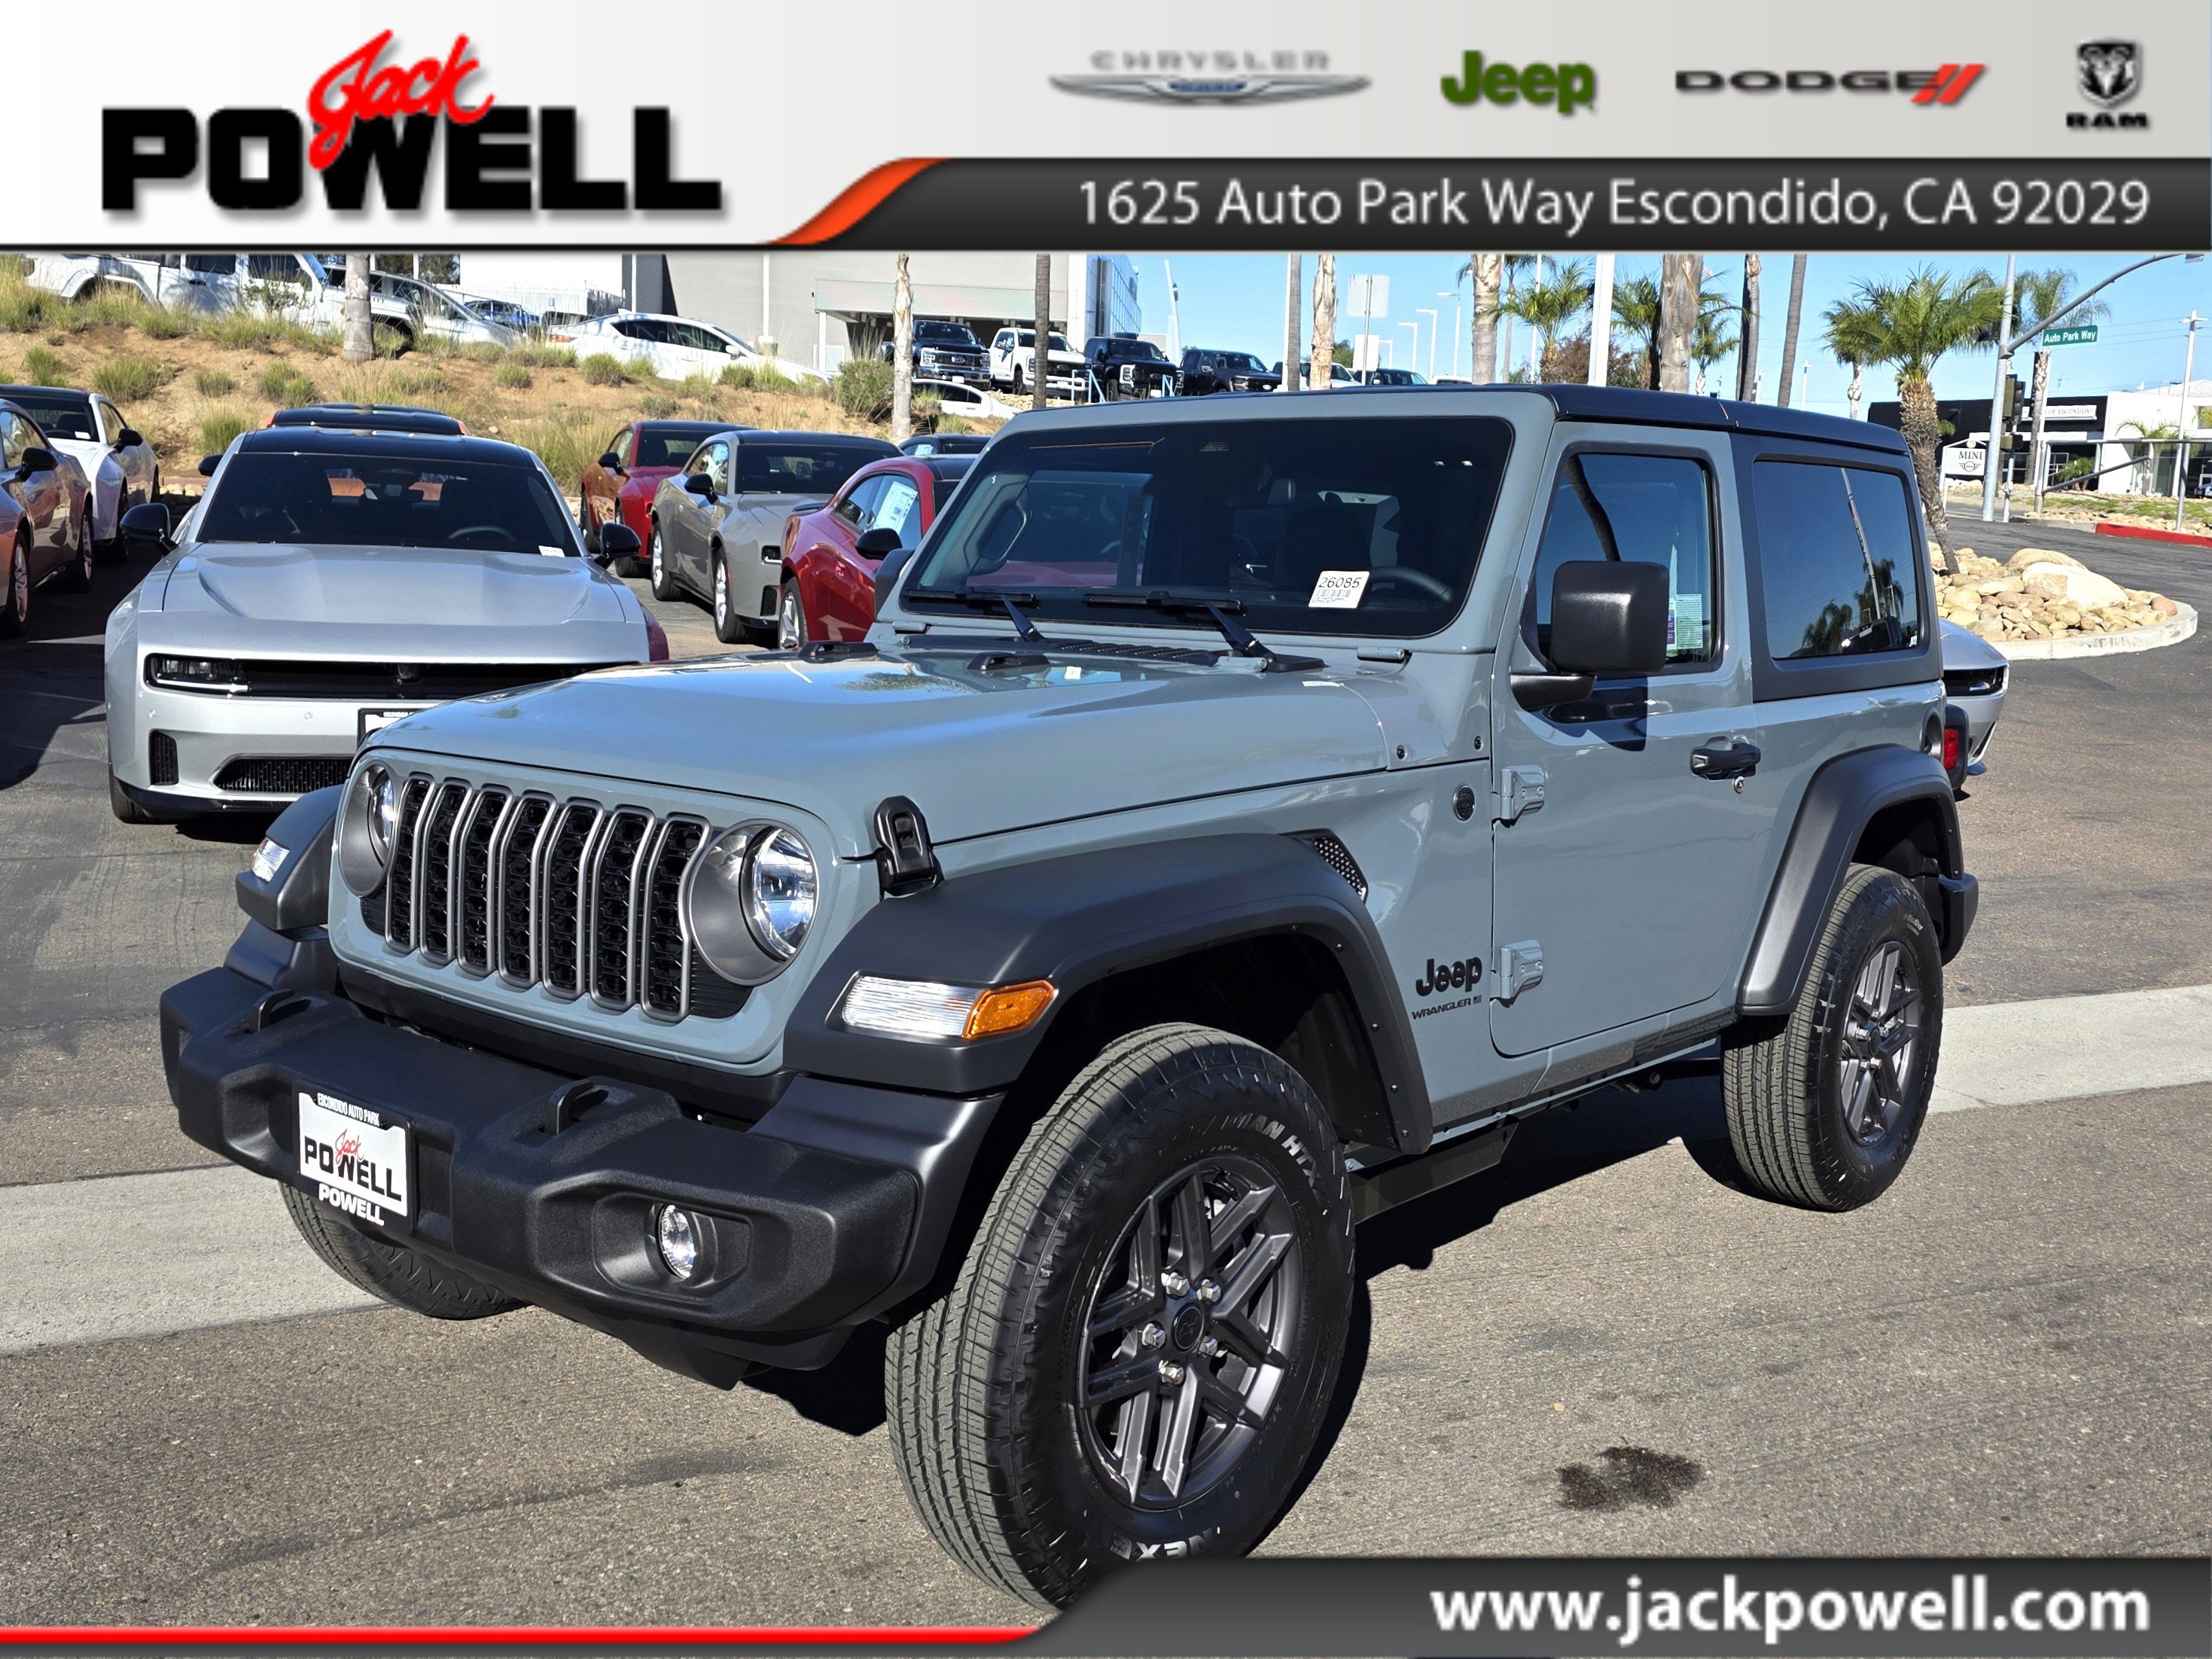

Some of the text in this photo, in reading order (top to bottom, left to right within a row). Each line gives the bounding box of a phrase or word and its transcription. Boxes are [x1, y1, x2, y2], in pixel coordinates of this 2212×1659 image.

[2044, 330, 2096, 343] Auto Park Way
[1958, 450, 1982, 460] MINI
[1318, 577, 1362, 588] 26085
[1415, 957, 1482, 996] Jeep
[1412, 998, 1471, 1020] WRANGLER
[317, 1092, 379, 1127] ESCONDIDO AUTO PARK
[335, 1129, 364, 1165] Jack
[304, 1135, 402, 1202] POWELL
[318, 1182, 385, 1227] POWELL
